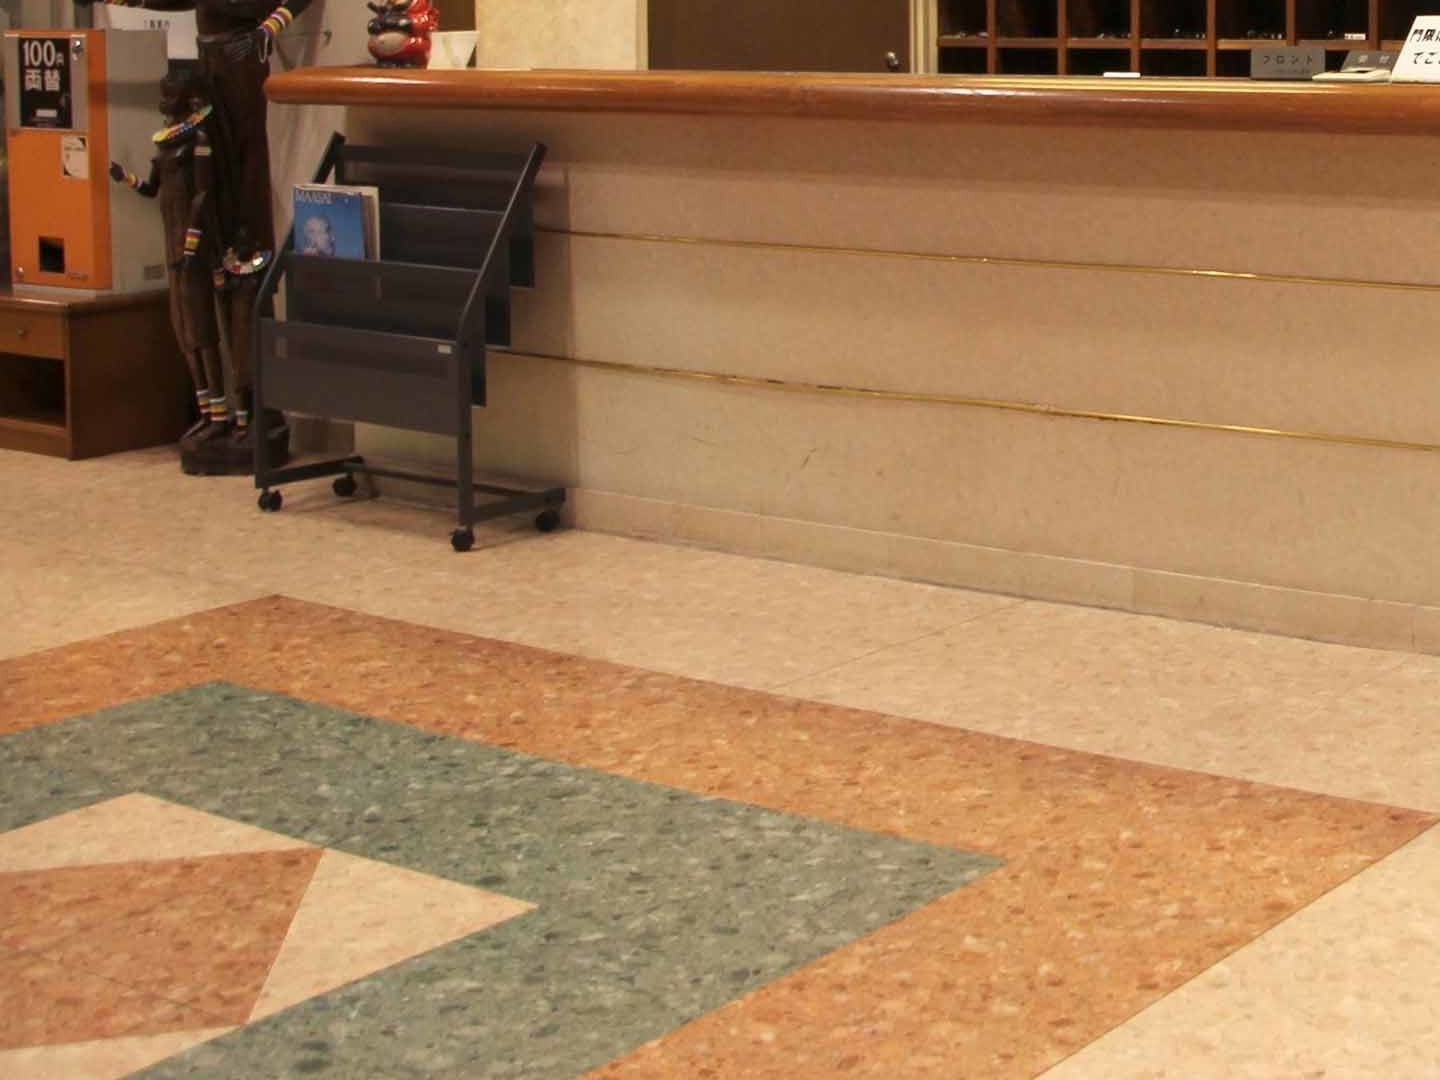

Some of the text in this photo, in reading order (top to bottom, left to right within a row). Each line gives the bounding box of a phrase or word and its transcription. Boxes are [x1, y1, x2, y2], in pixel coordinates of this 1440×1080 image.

[1262, 55, 1314, 65] フロント
[24, 68, 61, 92] 両替
